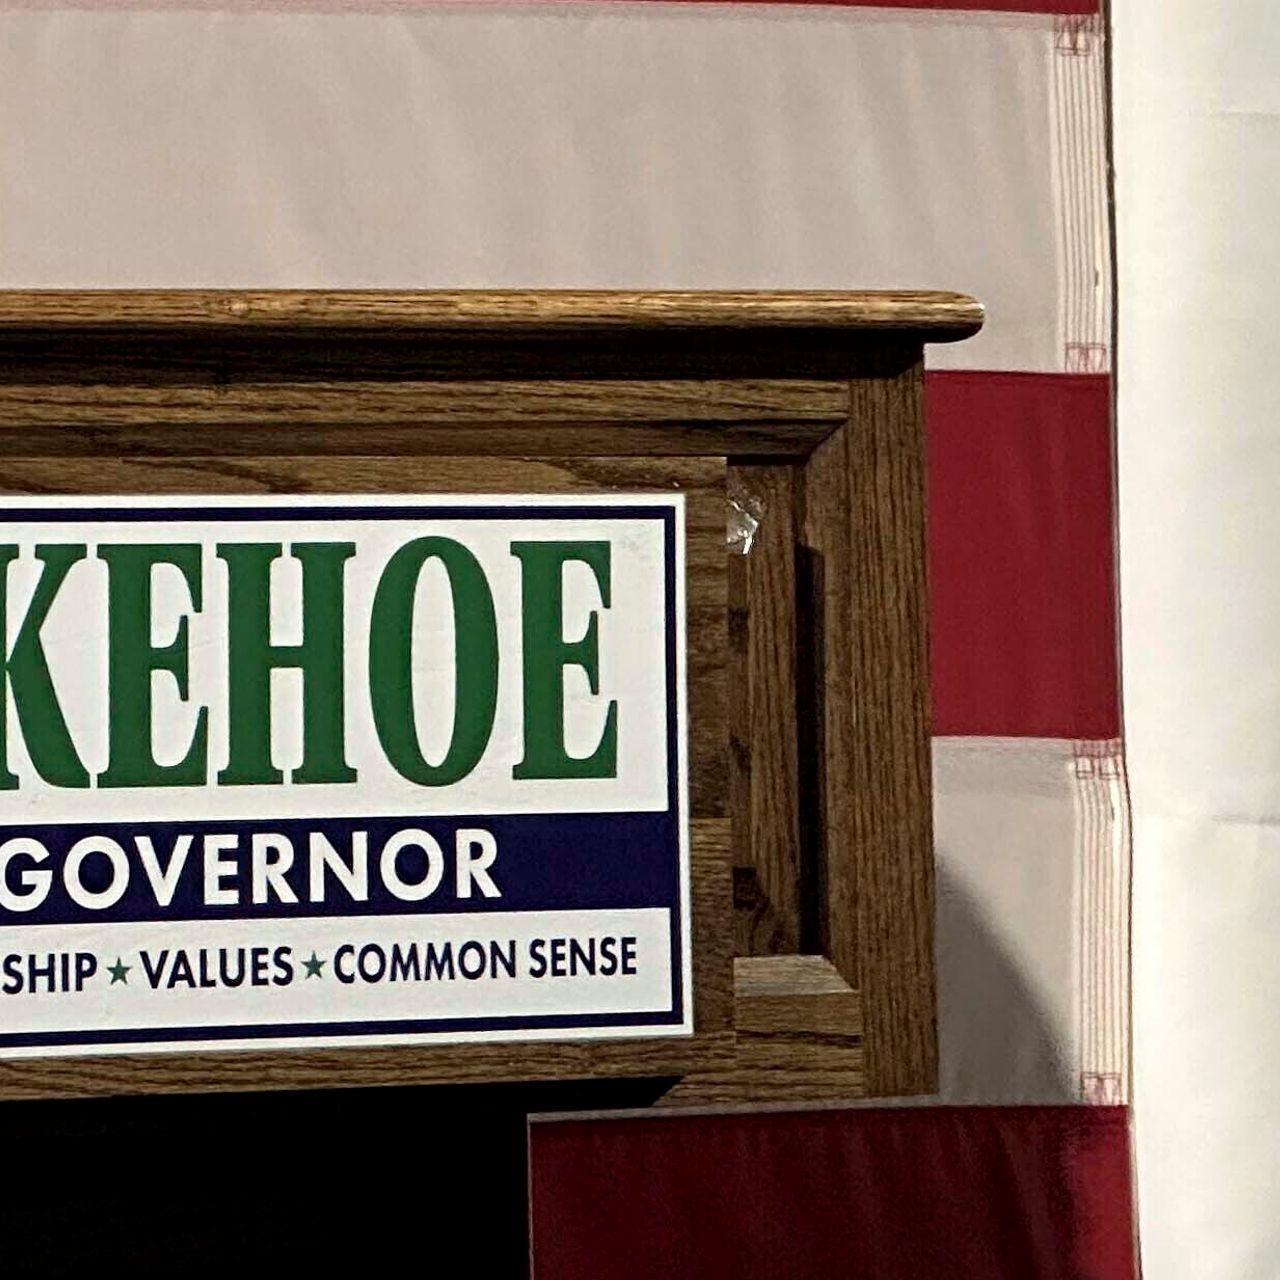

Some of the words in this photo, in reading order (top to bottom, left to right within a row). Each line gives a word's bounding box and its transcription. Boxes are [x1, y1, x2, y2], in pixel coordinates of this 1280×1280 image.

[140, 945, 294, 991] VALUES
[333, 938, 517, 986] COMMON
[529, 936, 638, 978] SENSE
